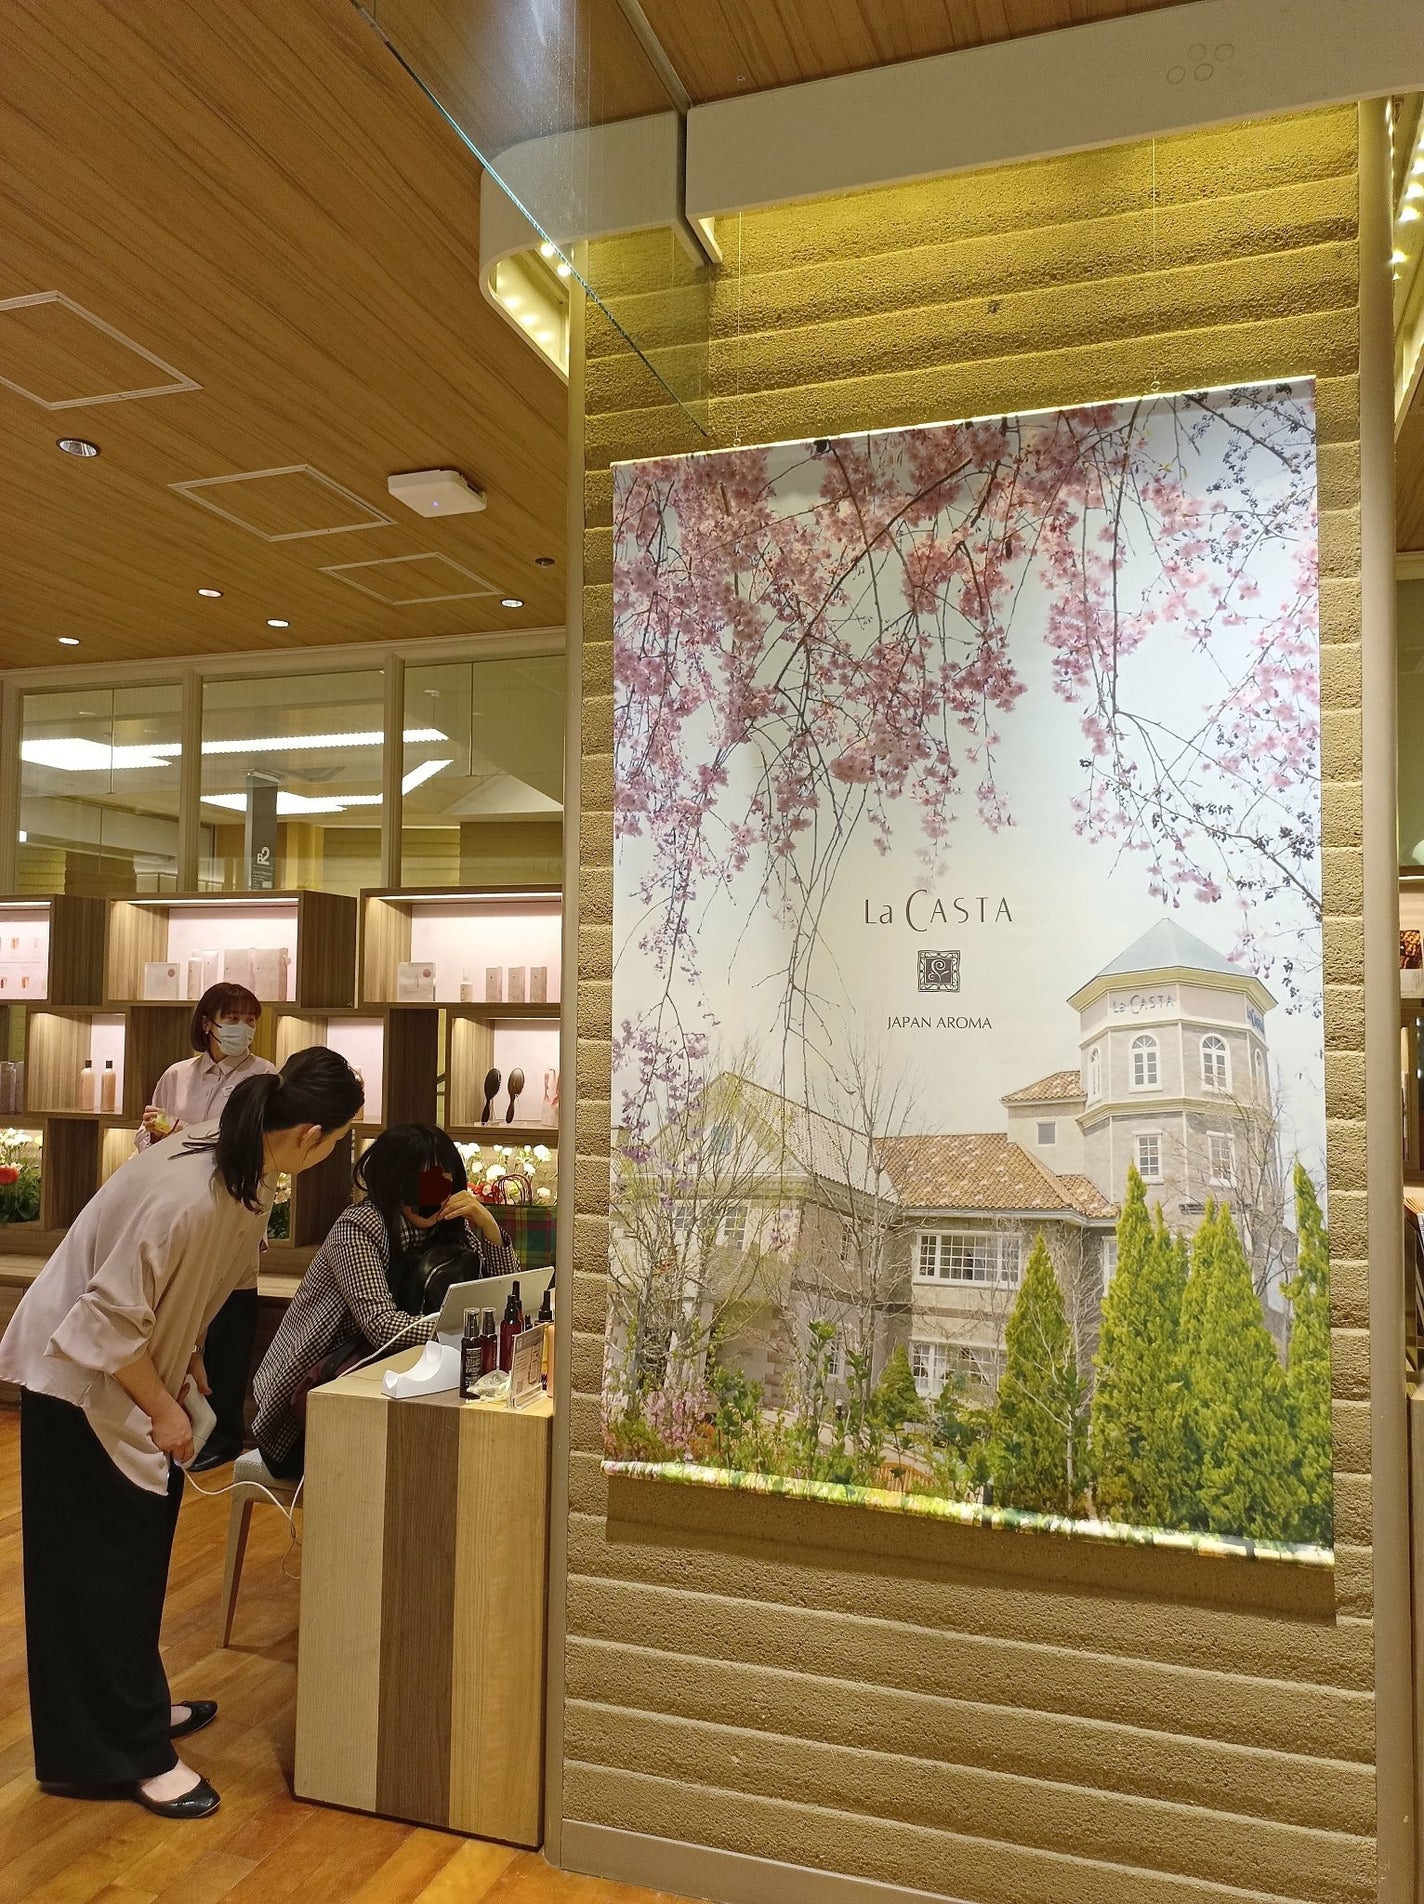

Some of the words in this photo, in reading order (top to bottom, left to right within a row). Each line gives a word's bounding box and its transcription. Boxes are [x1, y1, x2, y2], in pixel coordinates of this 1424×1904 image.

[256, 846, 270, 865] B2
[864, 899, 893, 925] La
[905, 889, 1013, 933] CASTA
[1130, 994, 1174, 1015] CASTA
[887, 1016, 932, 1031] JAPAN
[936, 1017, 992, 1030] AROMA
